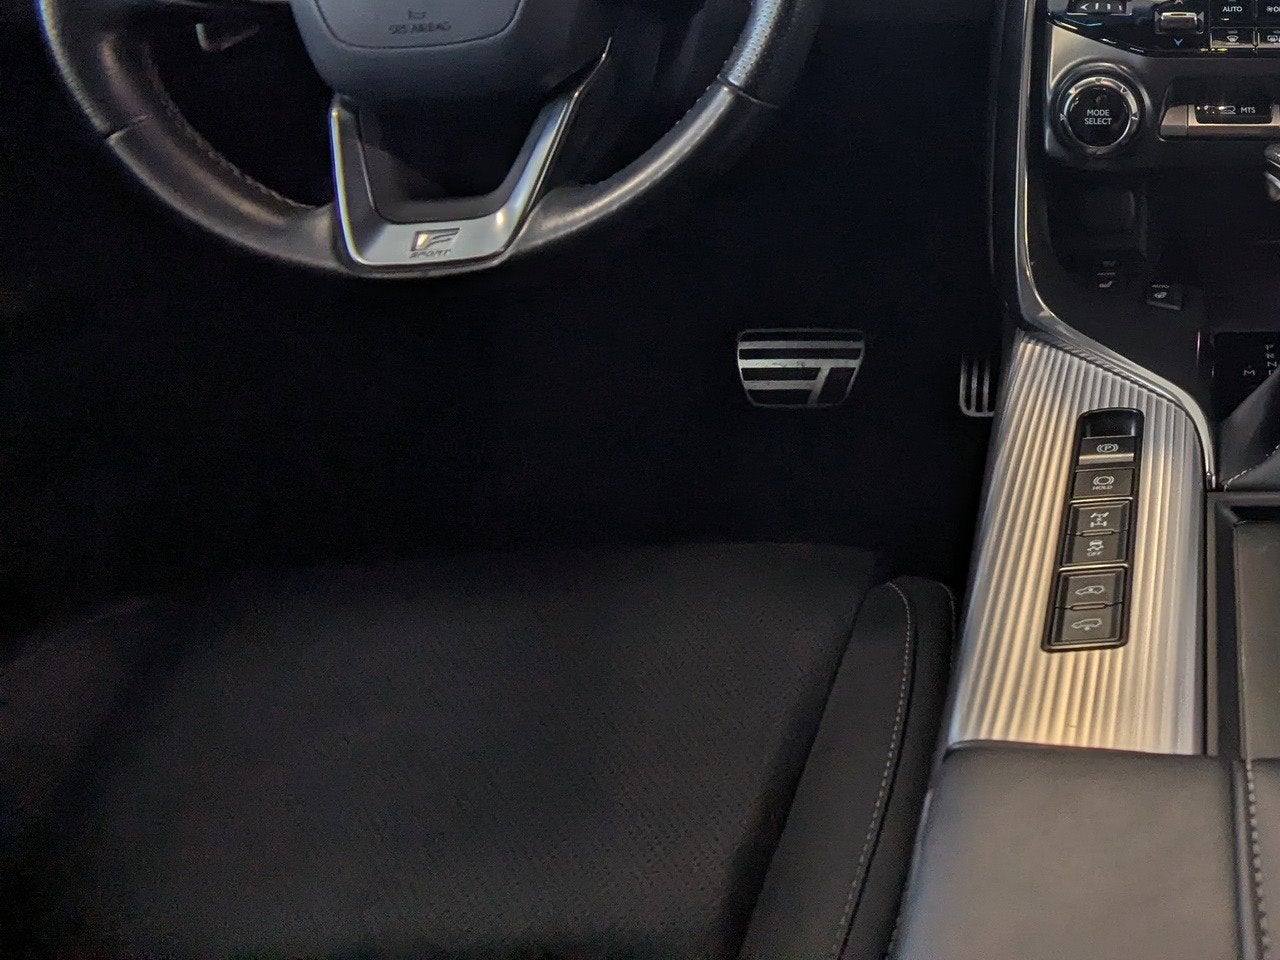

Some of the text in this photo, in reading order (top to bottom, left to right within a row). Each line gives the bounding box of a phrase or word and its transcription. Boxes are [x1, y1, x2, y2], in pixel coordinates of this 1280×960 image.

[1222, 5, 1243, 13] AUTO
[1086, 109, 1110, 117] MODE
[1240, 106, 1256, 114] MTS
[1084, 117, 1112, 125] SELECT
